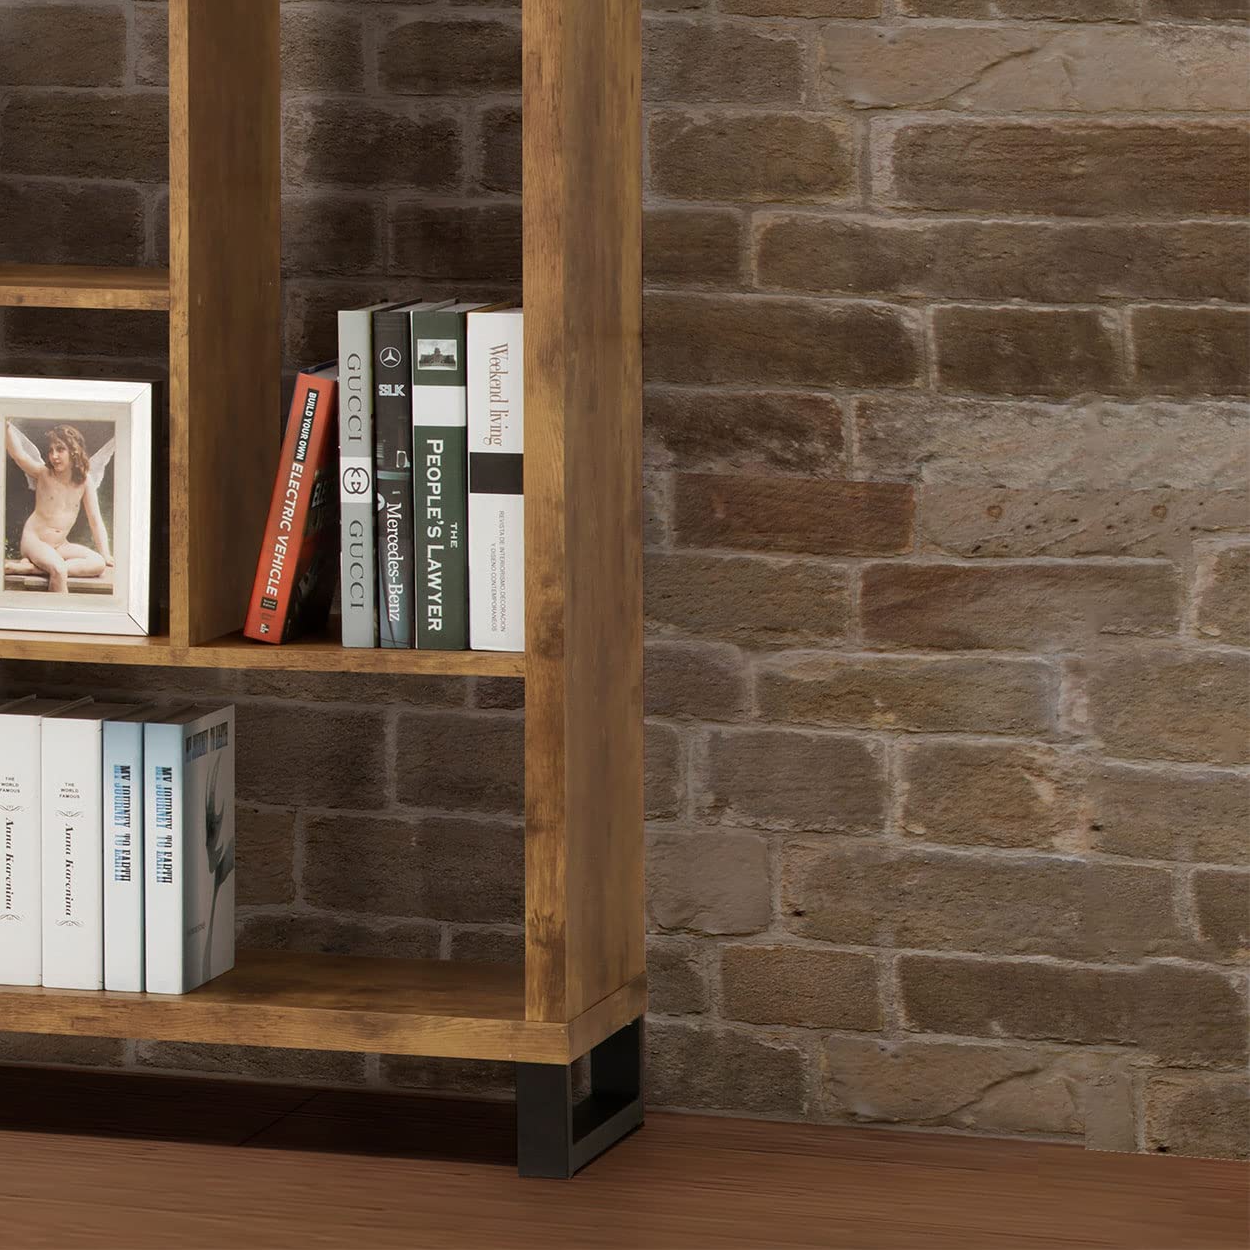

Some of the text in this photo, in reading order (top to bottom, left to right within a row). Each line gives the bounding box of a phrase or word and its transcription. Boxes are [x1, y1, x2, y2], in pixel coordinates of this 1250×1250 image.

[304, 390, 318, 417] BUILD
[346, 352, 363, 443] GUCCI
[378, 383, 406, 397] SLK
[483, 342, 510, 447] Weekend living
[295, 438, 307, 461] OWN
[299, 417, 312, 440] YOUR
[279, 461, 304, 532] ELECTRIC
[265, 535, 289, 598] VEHICLE
[348, 519, 365, 610] GUCCI
[386, 501, 405, 623] Mercedes-Benz
[426, 438, 445, 632] PEOPLE'S LAWYER
[450, 522, 458, 548] THE
